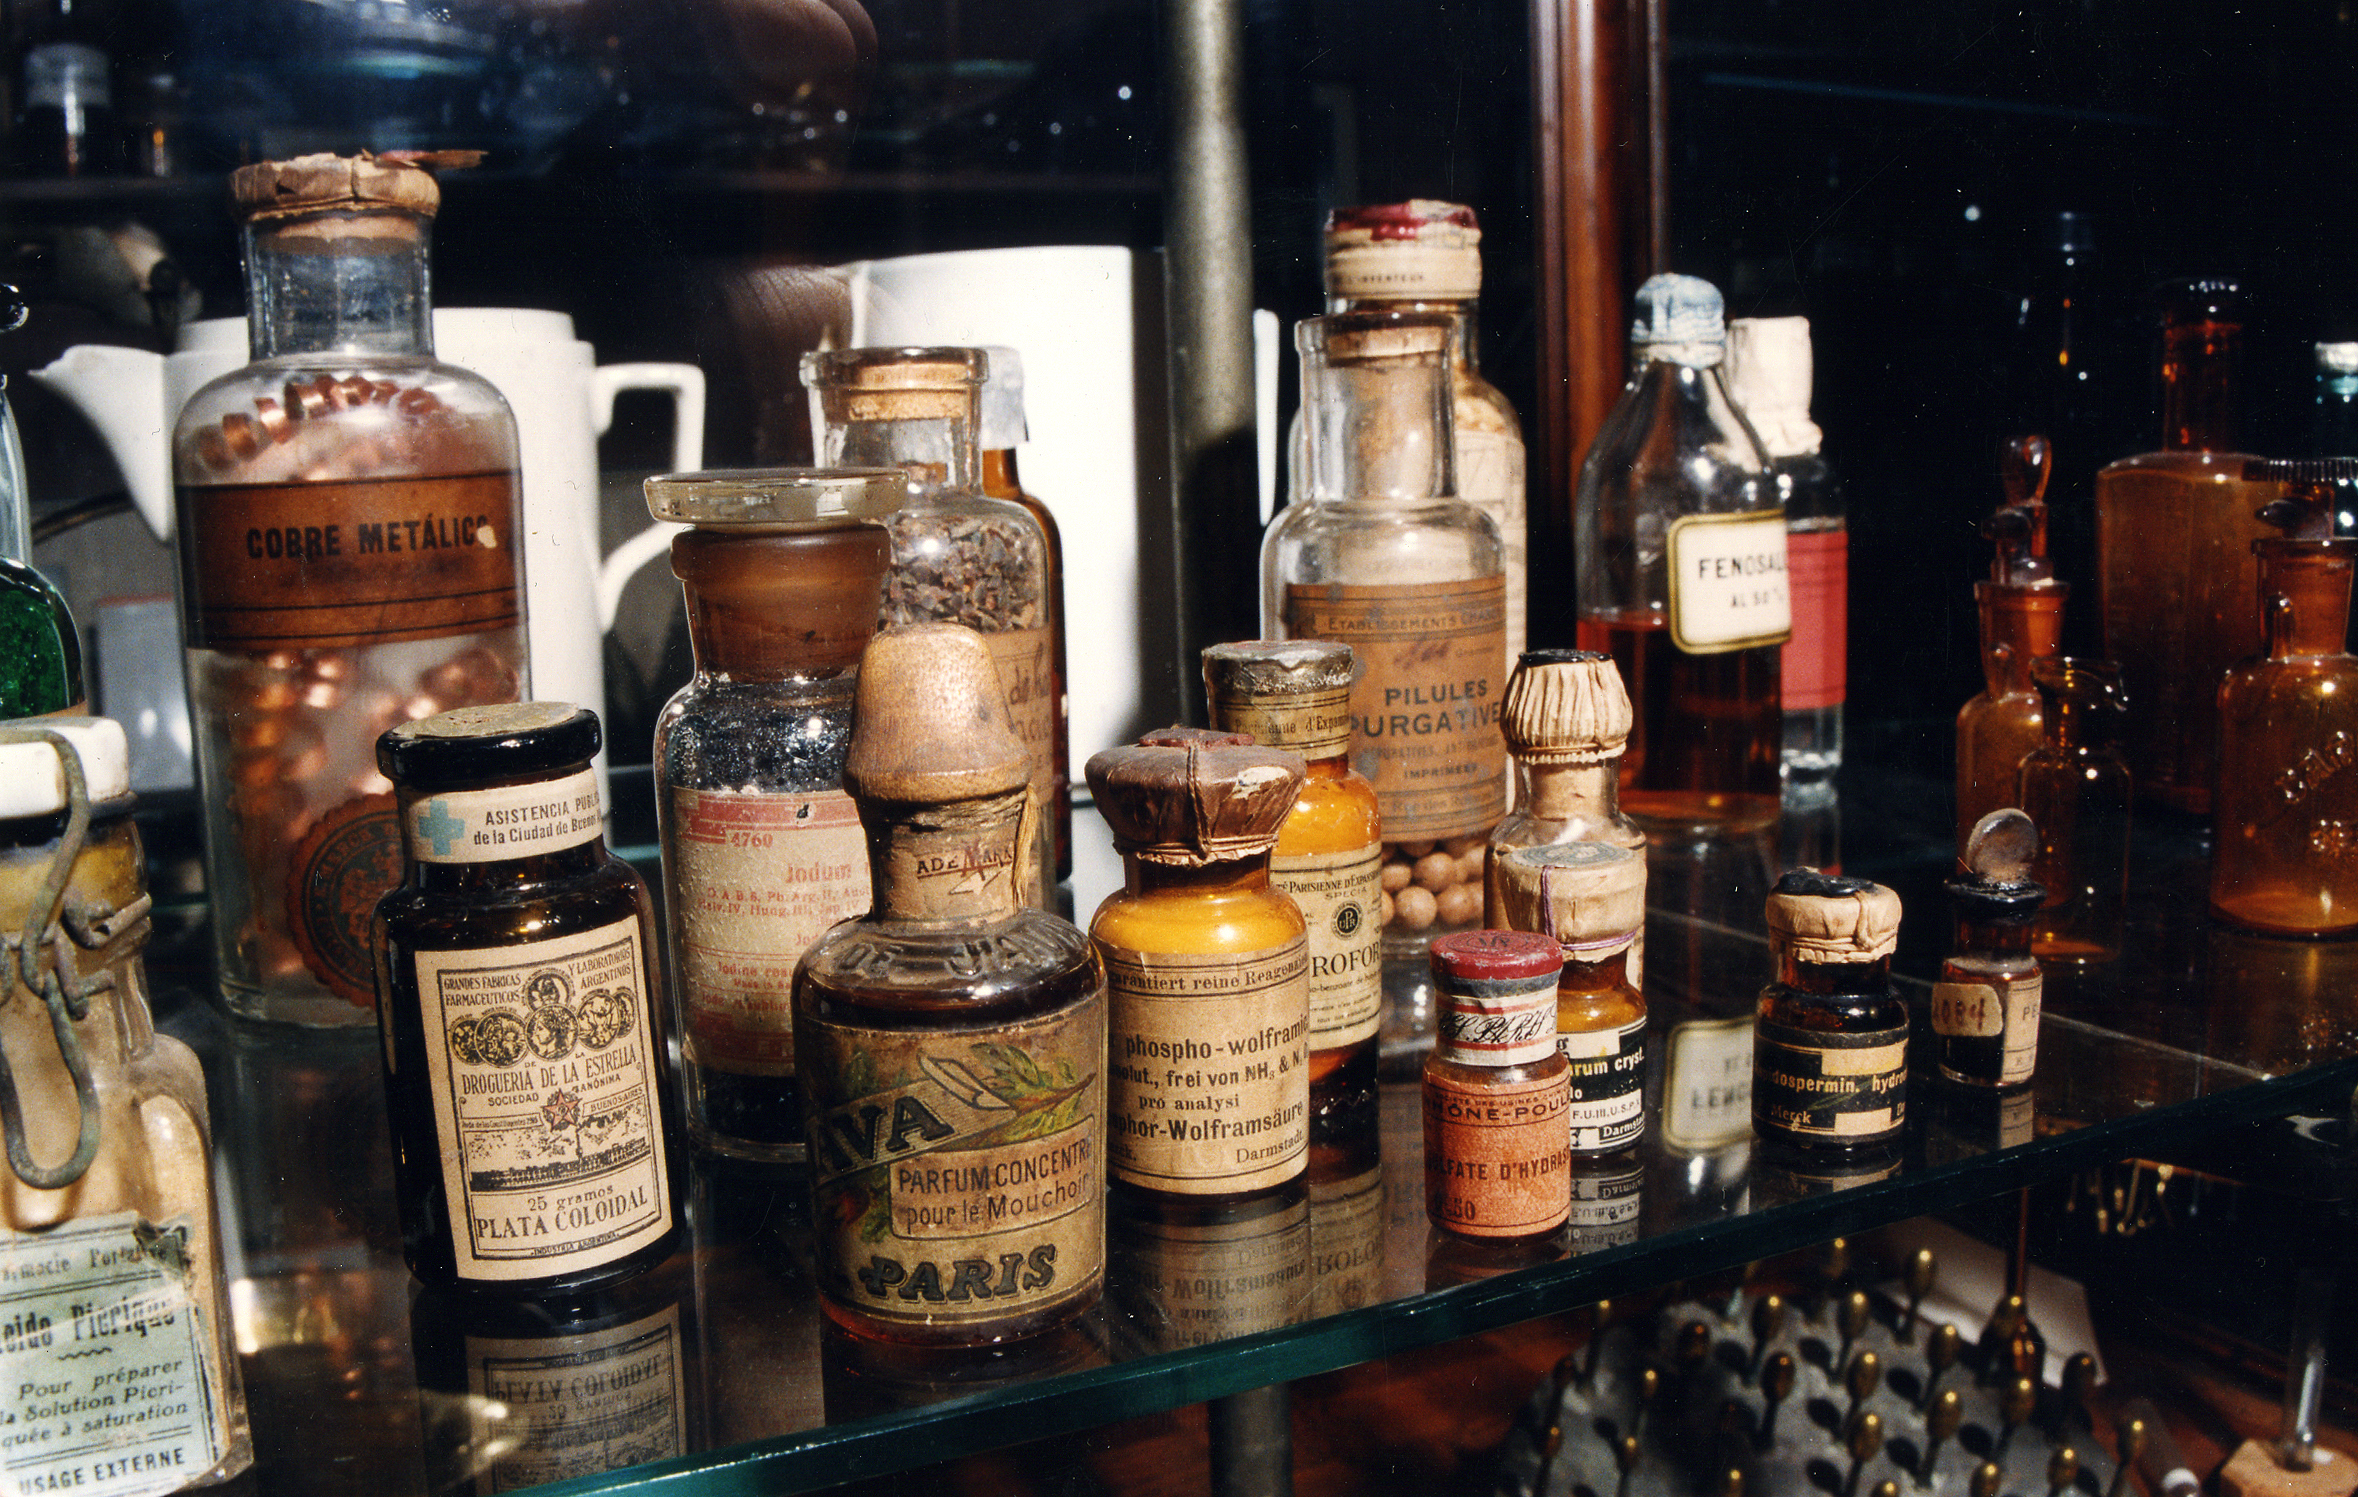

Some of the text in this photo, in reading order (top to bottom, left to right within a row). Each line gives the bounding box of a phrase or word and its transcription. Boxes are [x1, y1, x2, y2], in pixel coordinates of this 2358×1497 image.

[247, 524, 341, 559] COBRE
[1385, 679, 1487, 706] PILULES
[485, 800, 570, 826] ASISTENCIA
[473, 830, 489, 846] de
[493, 829, 505, 844] la
[509, 822, 553, 843] Ciudad
[556, 817, 568, 836] de
[731, 831, 774, 848] 4760
[444, 973, 522, 991] GRANDES FABRICAS
[1193, 975, 1240, 990] reine
[461, 1044, 637, 1095] DROGUERIA DE LA ESTRELLA
[524, 1060, 536, 1069] DE
[1166, 1070, 1201, 1087] frei
[1208, 1071, 1239, 1087] von
[1279, 1055, 1290, 1074] &
[488, 1073, 621, 1108] SOCIEDAD ANÓNIMA
[1138, 1093, 1240, 1113] pro analysi
[899, 1166, 990, 1193] PARFUM
[476, 1184, 648, 1239] PLATA COLOIDAL
[527, 1184, 614, 1212] 25 gramos
[907, 1171, 1090, 1234] pour le Mouchoir
[857, 1243, 1057, 1304] PARIS
[19, 1360, 184, 1401] Pour préparer
[25, 1394, 116, 1422] Solution
[124, 1382, 185, 1404] Picri-
[61, 1421, 72, 1437] à
[83, 1401, 188, 1433] saturation
[18, 1447, 186, 1497] USAGE EXTERNE
